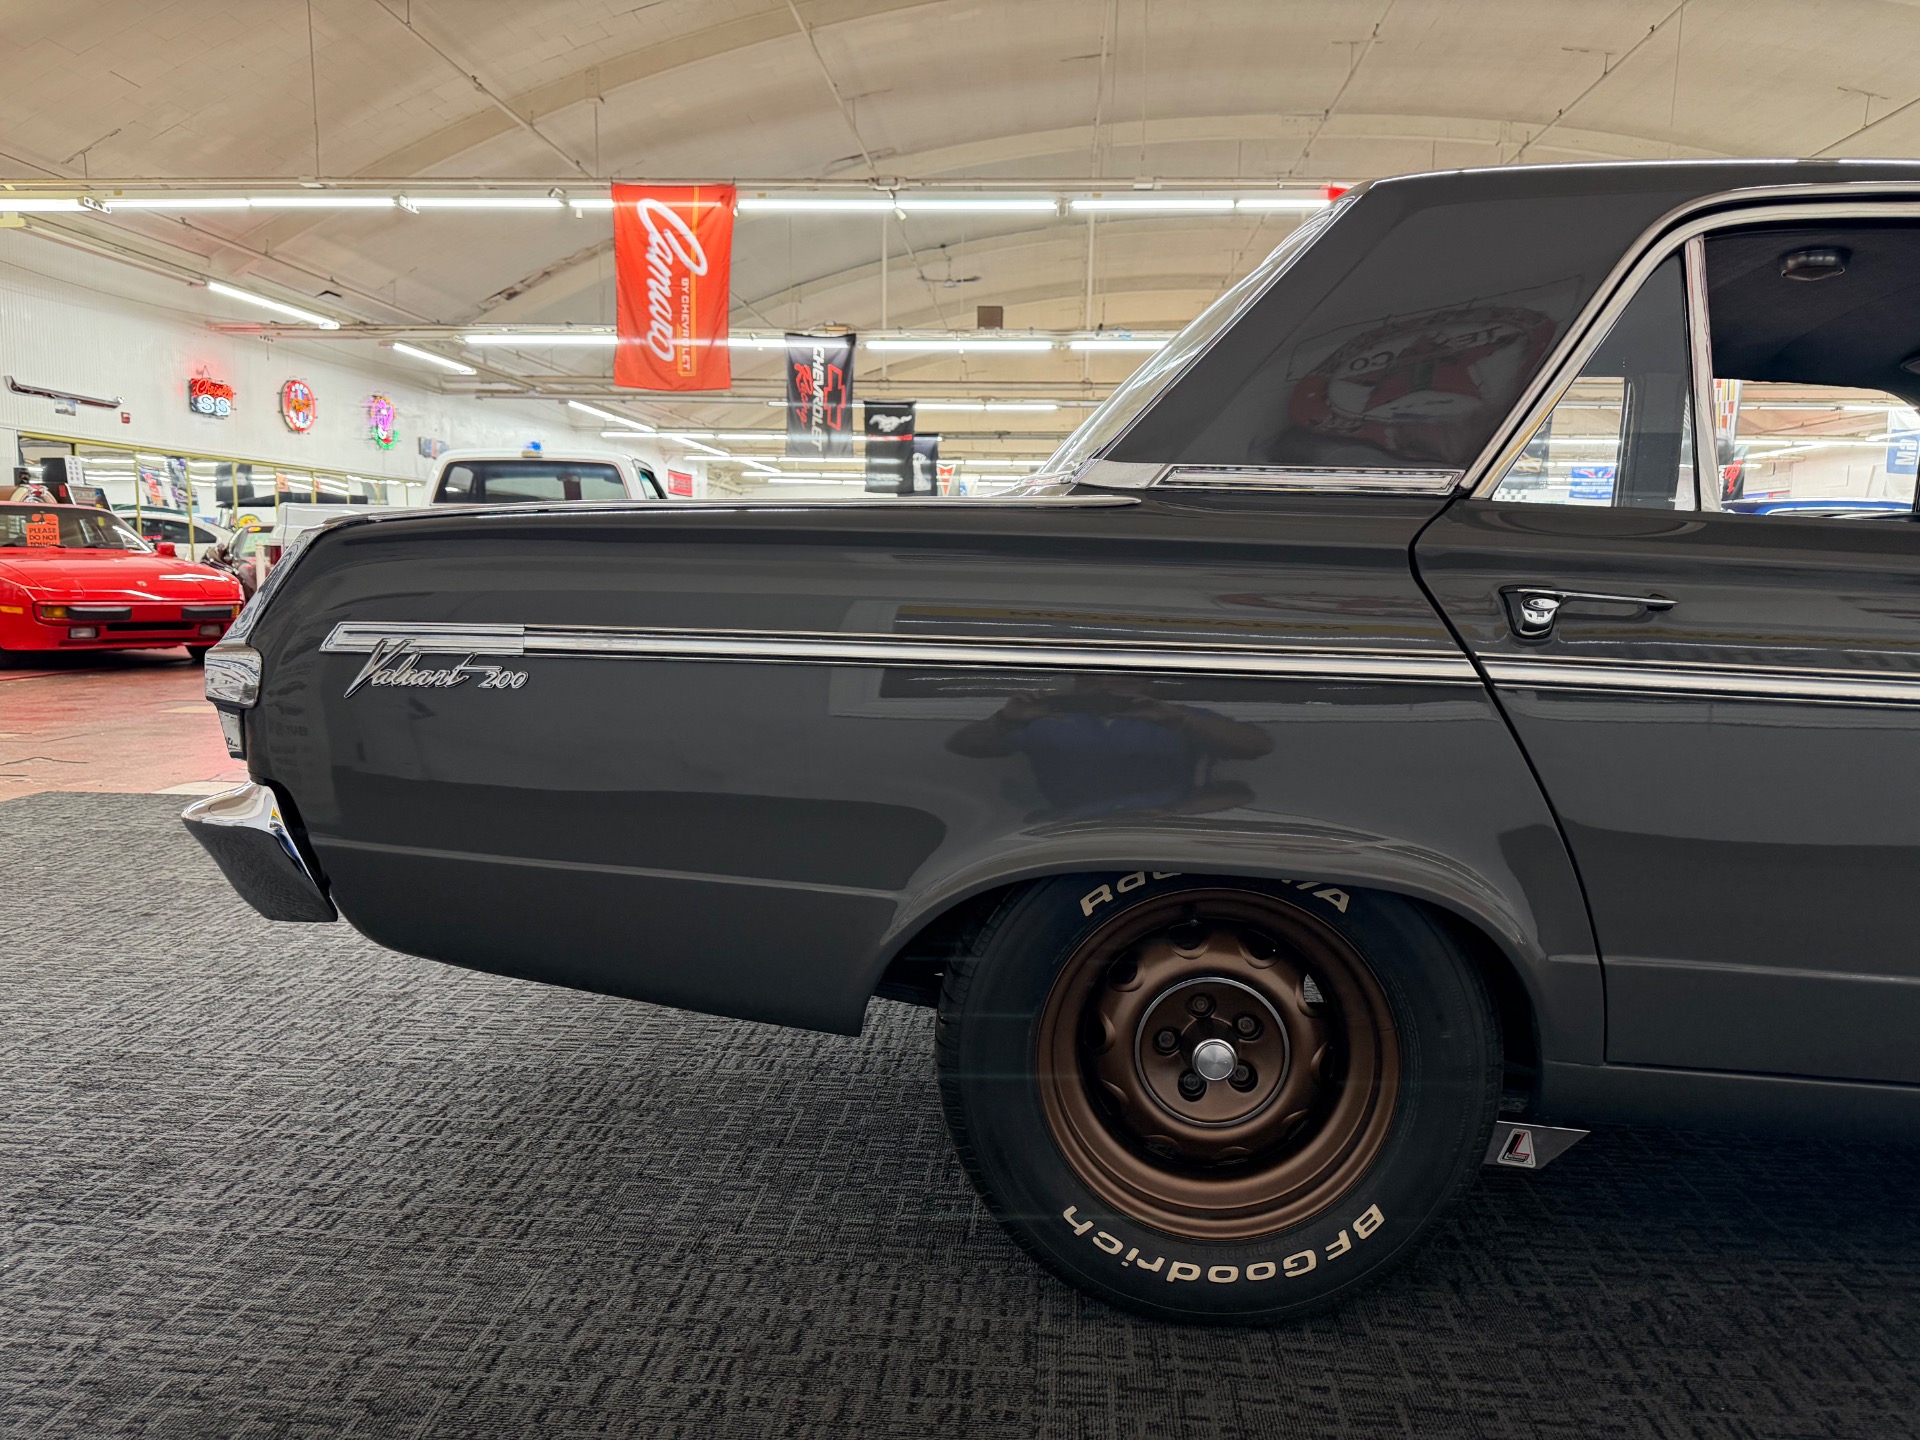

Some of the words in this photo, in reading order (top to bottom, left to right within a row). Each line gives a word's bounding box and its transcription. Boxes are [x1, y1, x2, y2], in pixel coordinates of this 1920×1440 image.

[637, 198, 708, 361] Camaro
[682, 278, 690, 294] BY
[681, 295, 690, 371] CHEVROLET
[197, 394, 231, 416] SS
[812, 346, 824, 452] CHEVROLET
[344, 637, 503, 699] Valiant
[478, 669, 529, 689] 200
[1062, 1203, 1386, 1284] BFGoodrich
